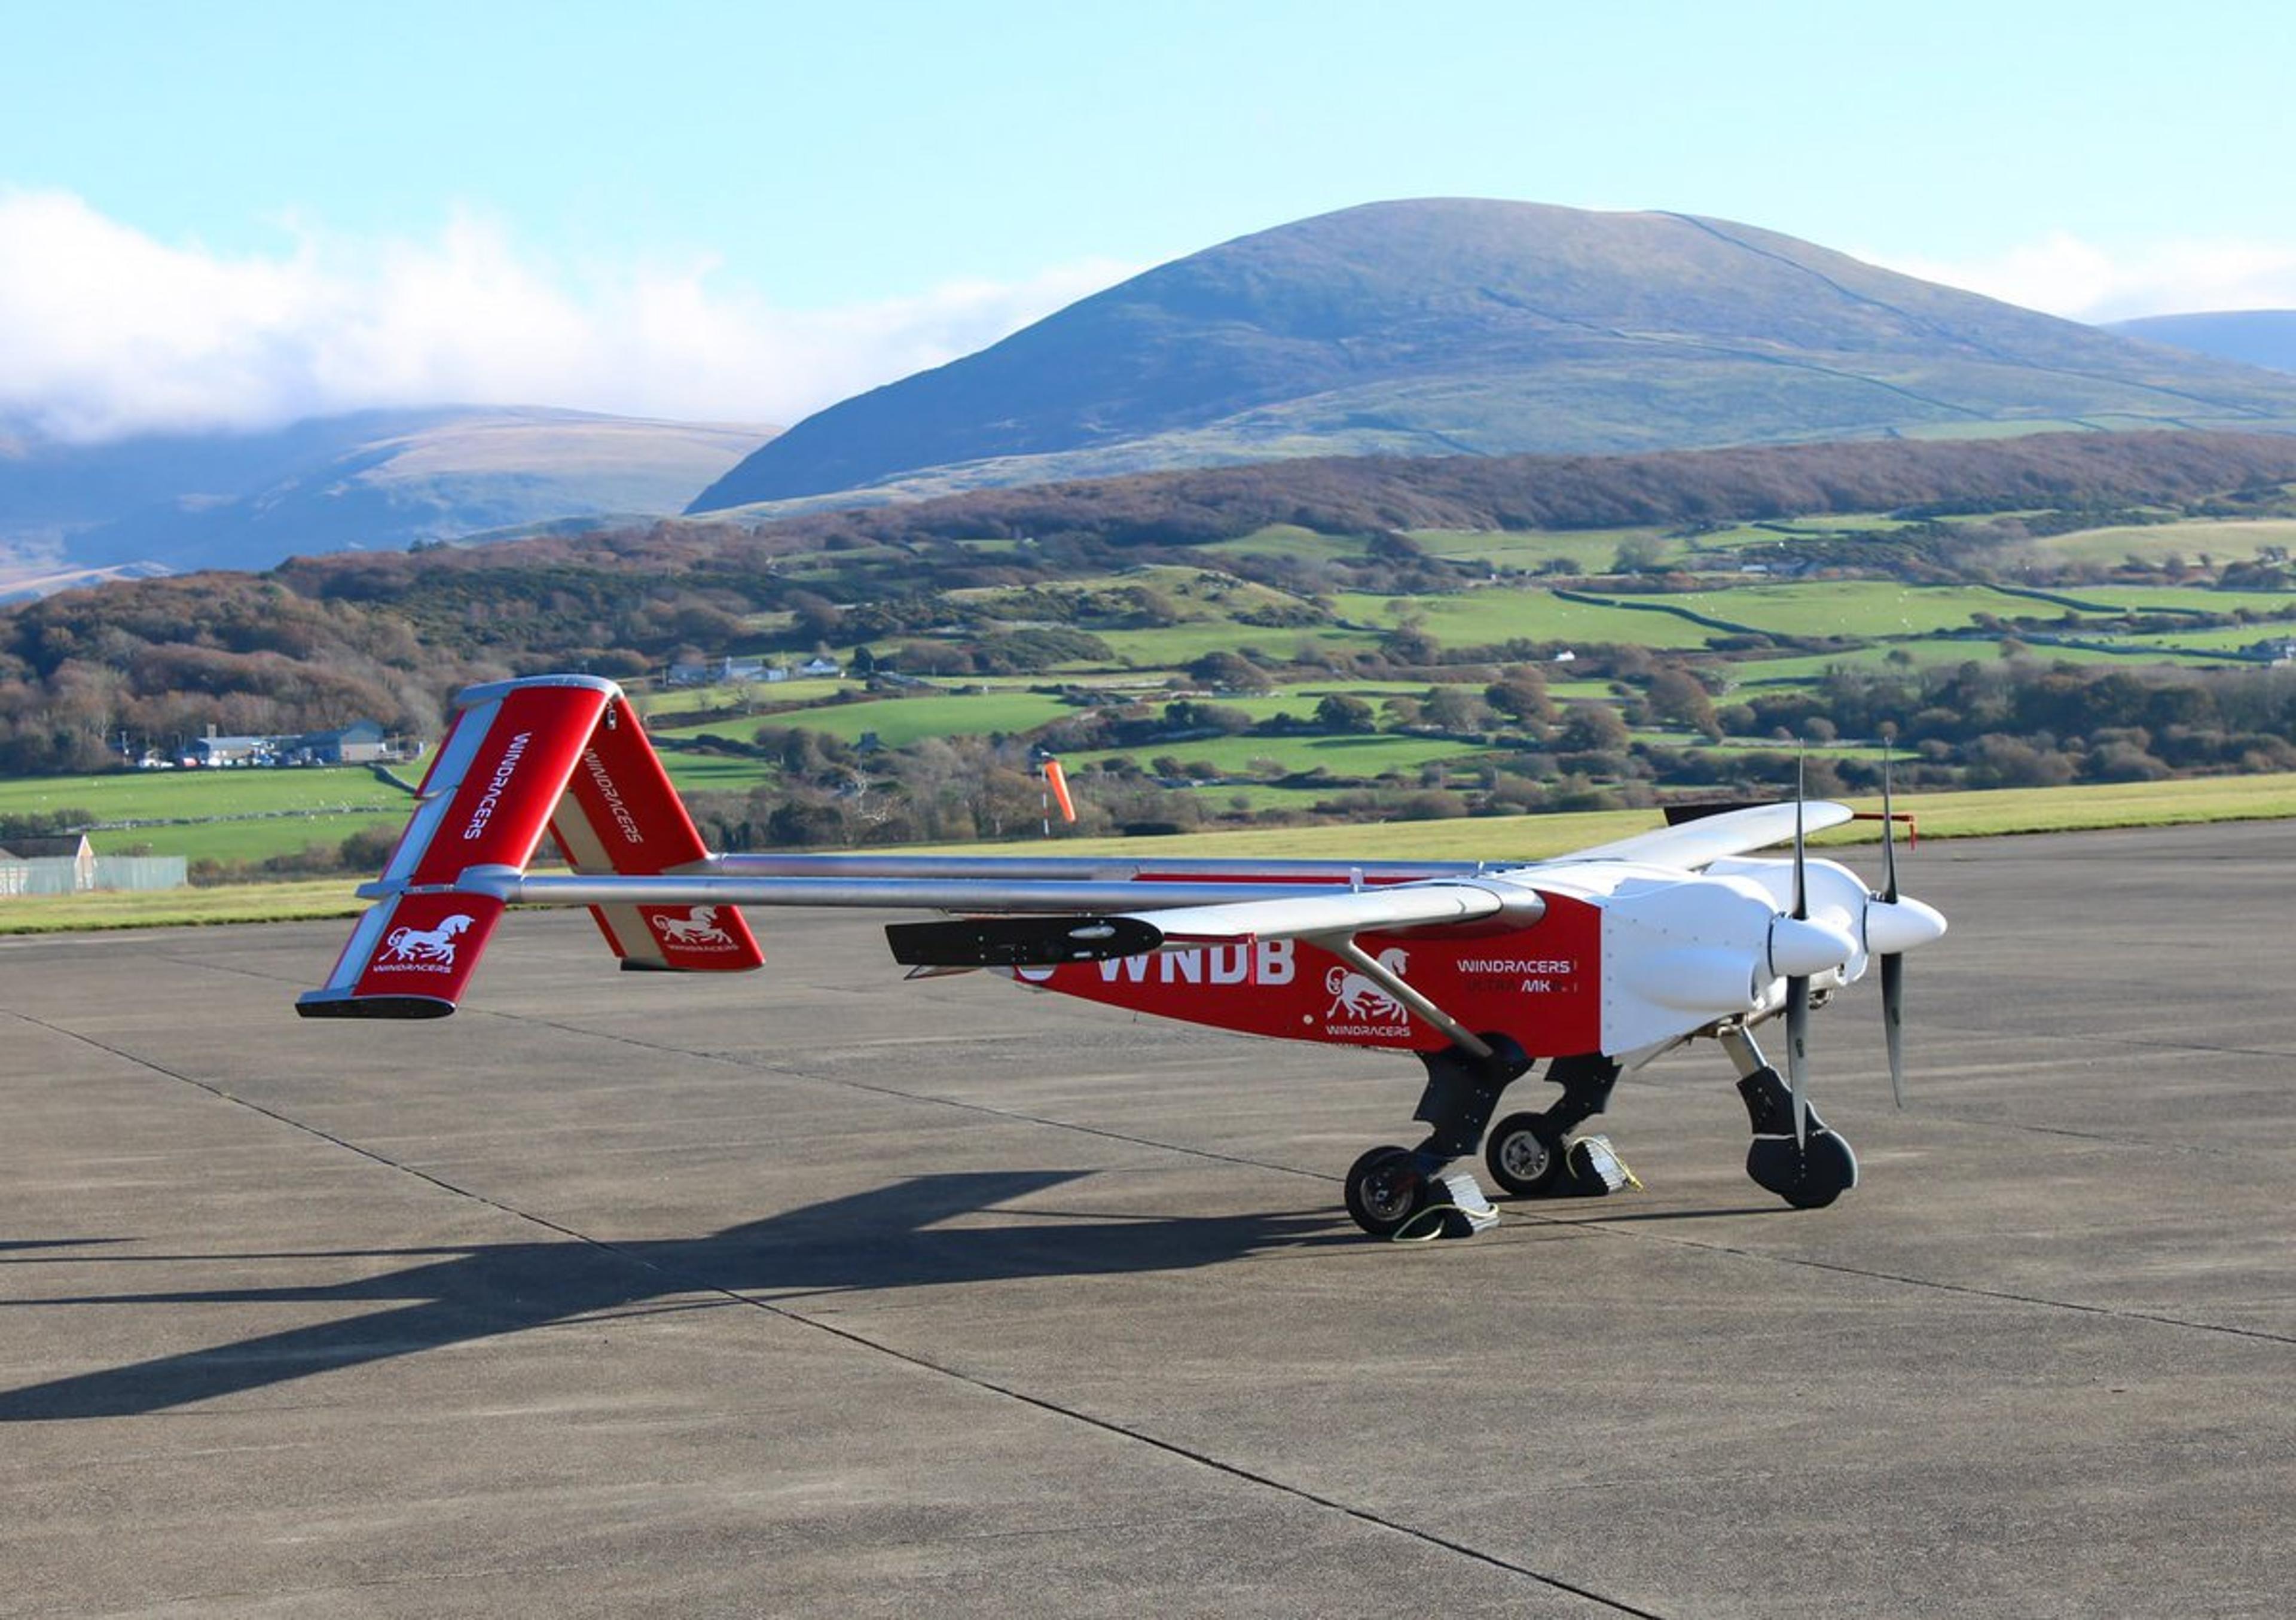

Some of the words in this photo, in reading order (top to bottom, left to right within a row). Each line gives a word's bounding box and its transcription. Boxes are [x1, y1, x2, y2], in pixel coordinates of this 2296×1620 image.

[464, 731, 532, 840] WINDRACERS
[584, 748, 644, 844] WINDRACERS
[373, 964, 452, 974] WINDRACERS
[1457, 960, 1570, 974] WINDRACERS
[1326, 1026, 1411, 1037] WINDRACERS
